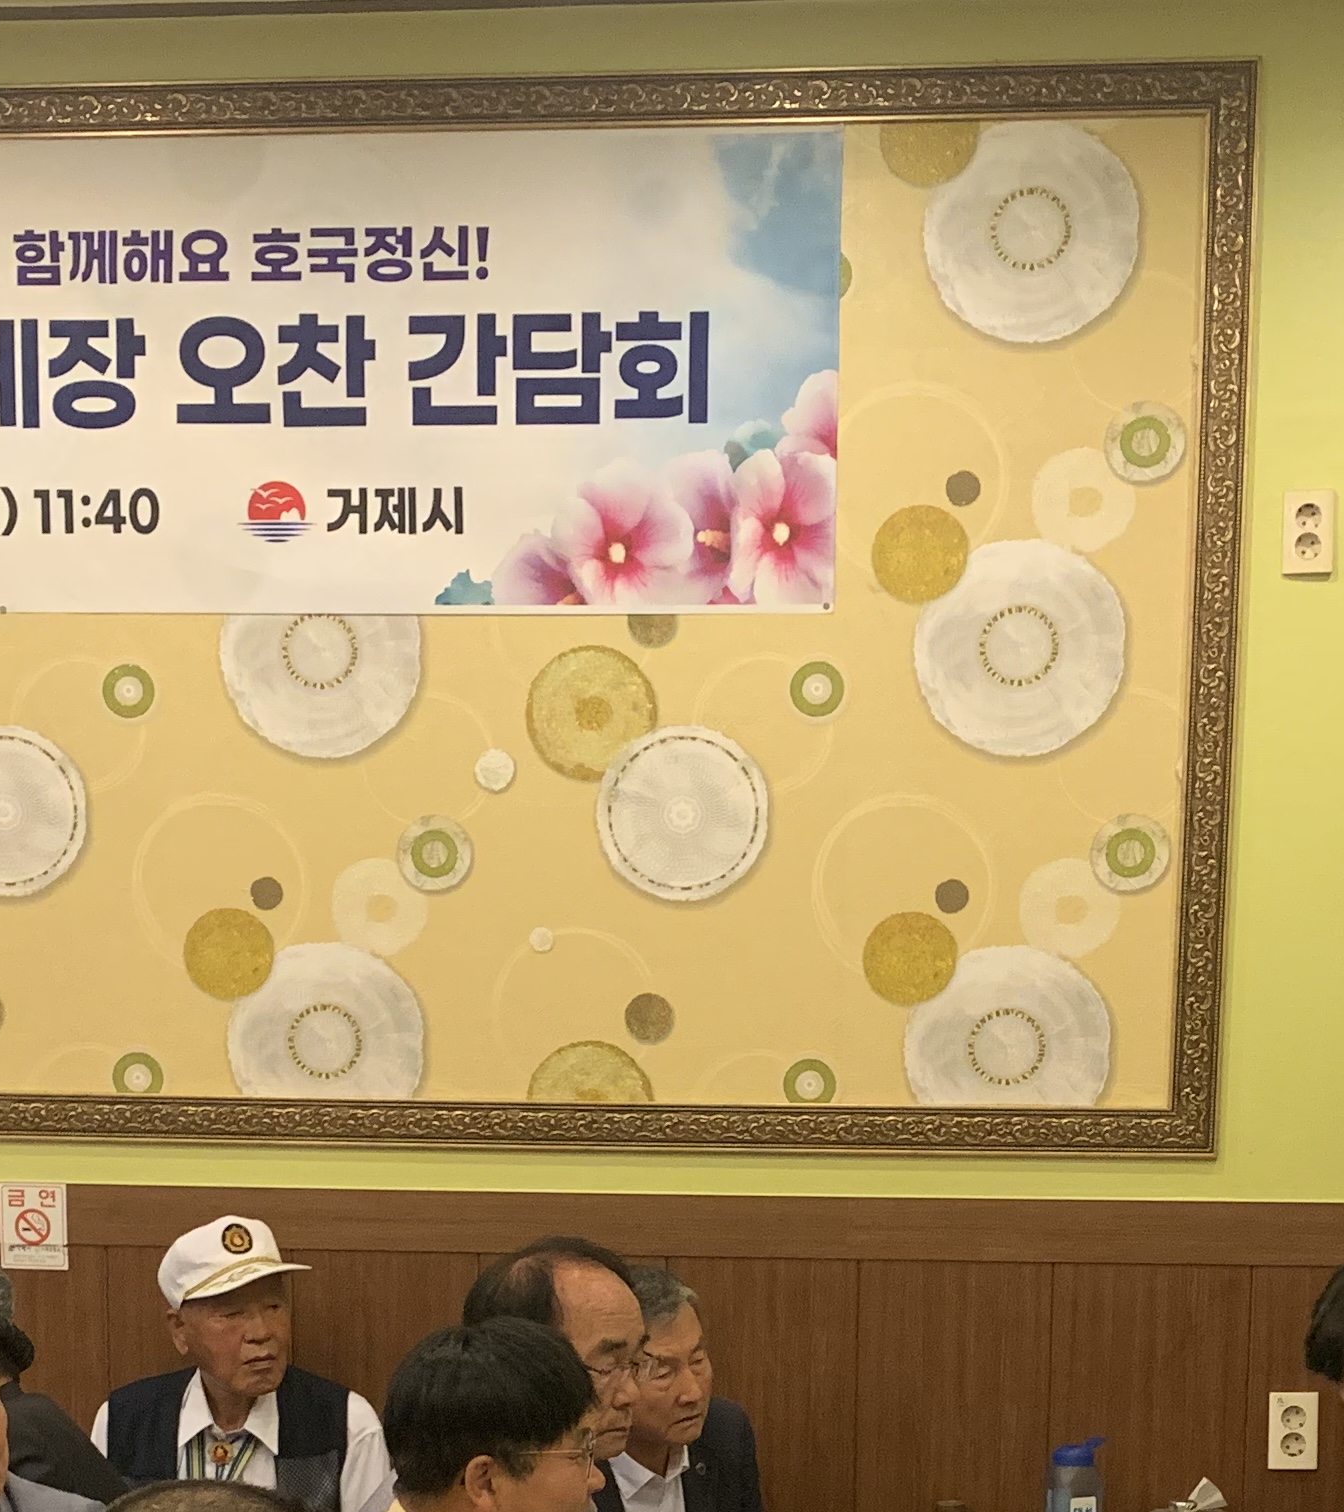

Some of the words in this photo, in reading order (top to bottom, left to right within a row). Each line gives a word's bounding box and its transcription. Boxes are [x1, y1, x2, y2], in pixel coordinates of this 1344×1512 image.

[13, 229, 229, 286] 함께해요
[251, 225, 489, 283] 호국정신!
[177, 313, 376, 427] 오찬
[408, 311, 709, 426] 간담회
[34, 488, 159, 535] 11:40
[327, 486, 463, 535] 거제시
